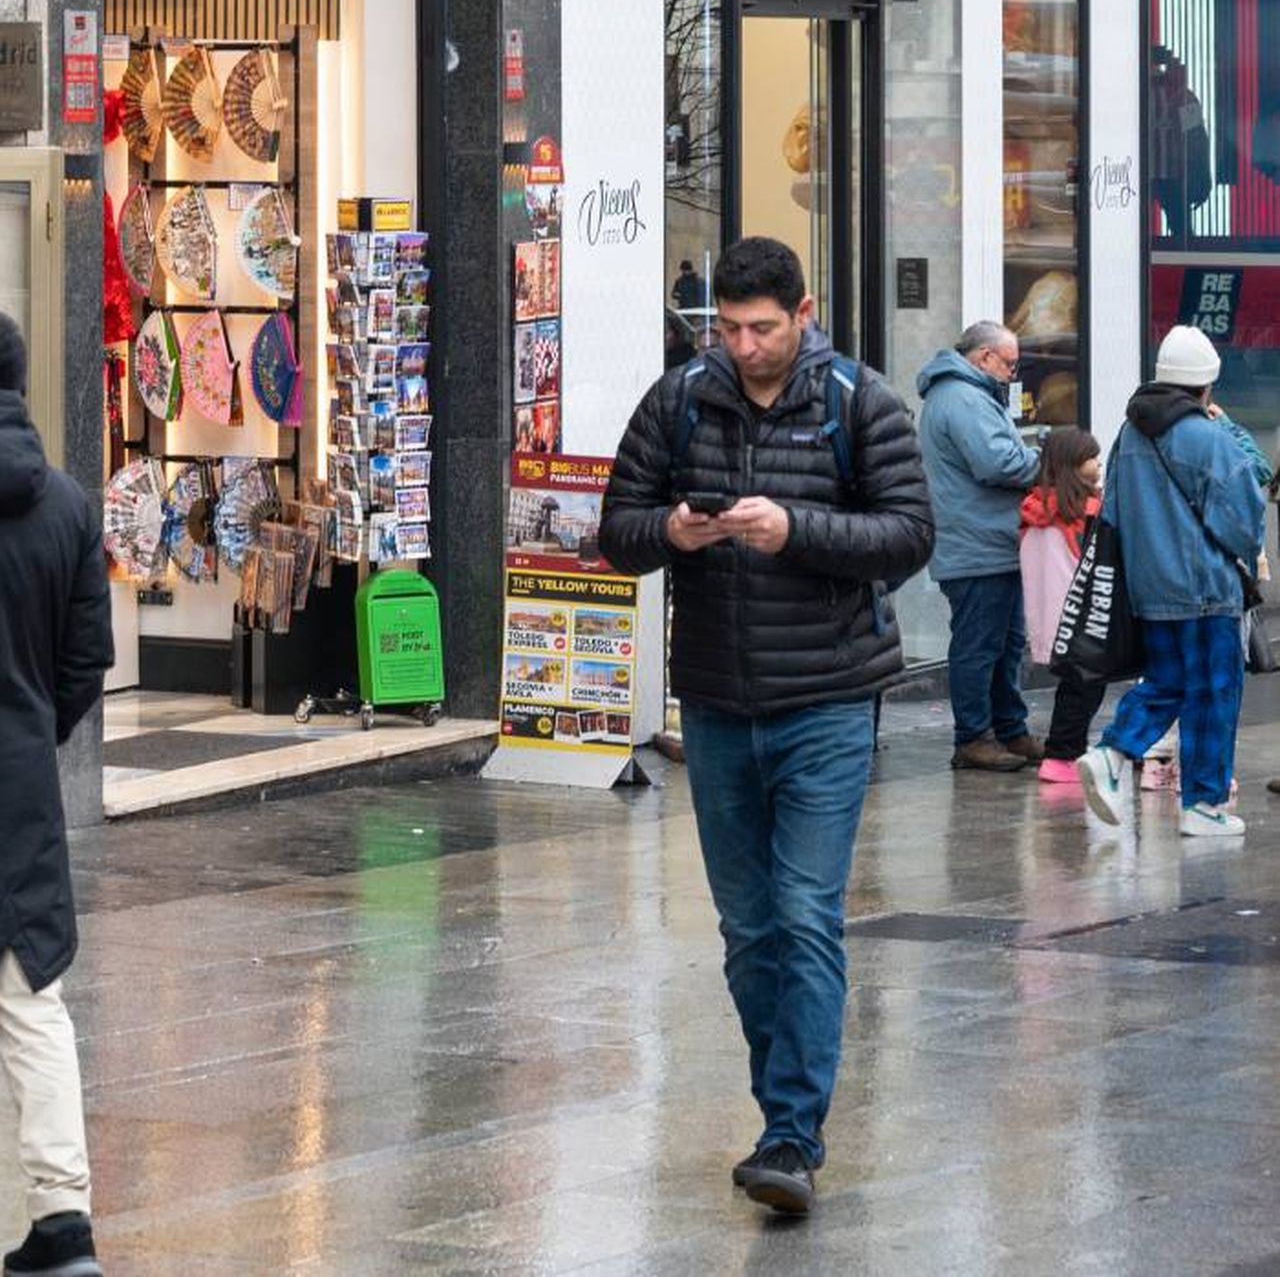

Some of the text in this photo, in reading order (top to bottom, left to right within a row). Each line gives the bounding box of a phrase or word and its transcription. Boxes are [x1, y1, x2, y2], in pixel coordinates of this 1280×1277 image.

[1201, 273, 1235, 292] RE
[1198, 294, 1231, 312] BA
[512, 575, 633, 597] THE YELLOW TOURS
[1085, 565, 1115, 640] URBAN
